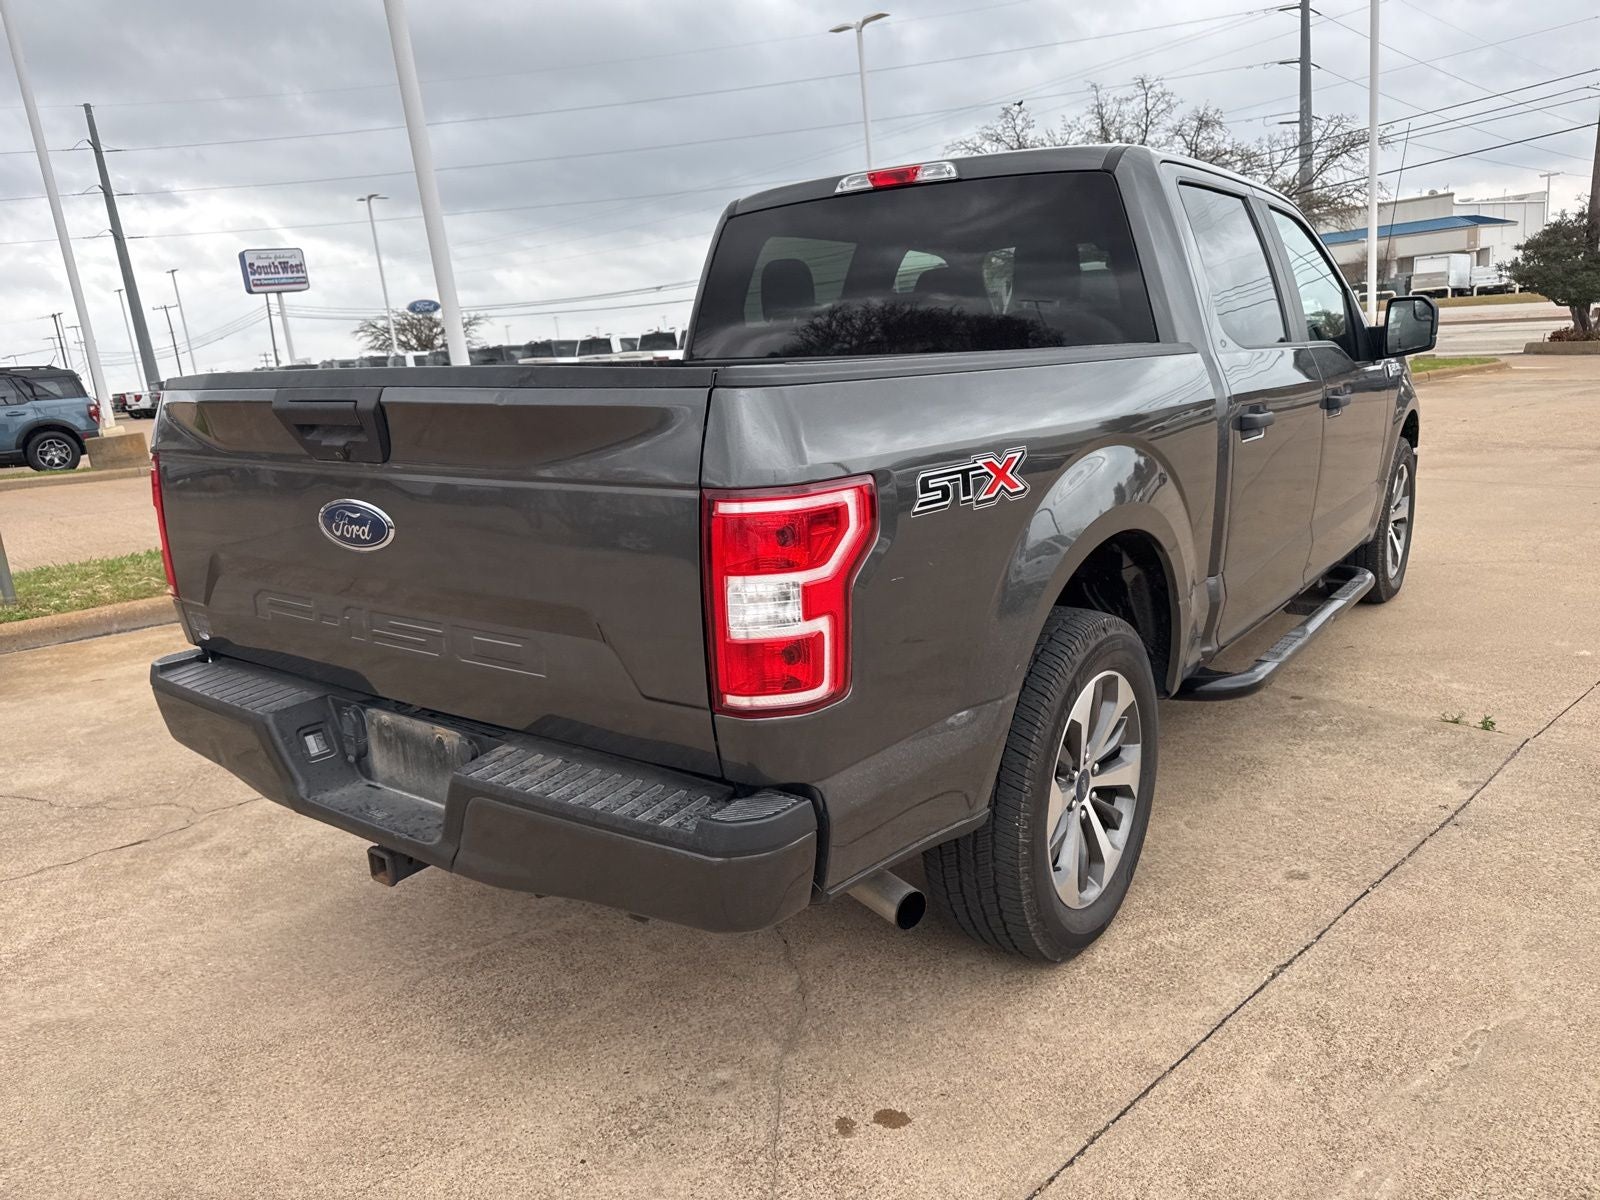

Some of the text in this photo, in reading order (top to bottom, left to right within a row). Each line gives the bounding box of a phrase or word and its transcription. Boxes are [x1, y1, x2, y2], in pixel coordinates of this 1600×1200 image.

[911, 446, 1030, 518] STX
[332, 509, 373, 540] Ford
[253, 589, 547, 677] F-150
